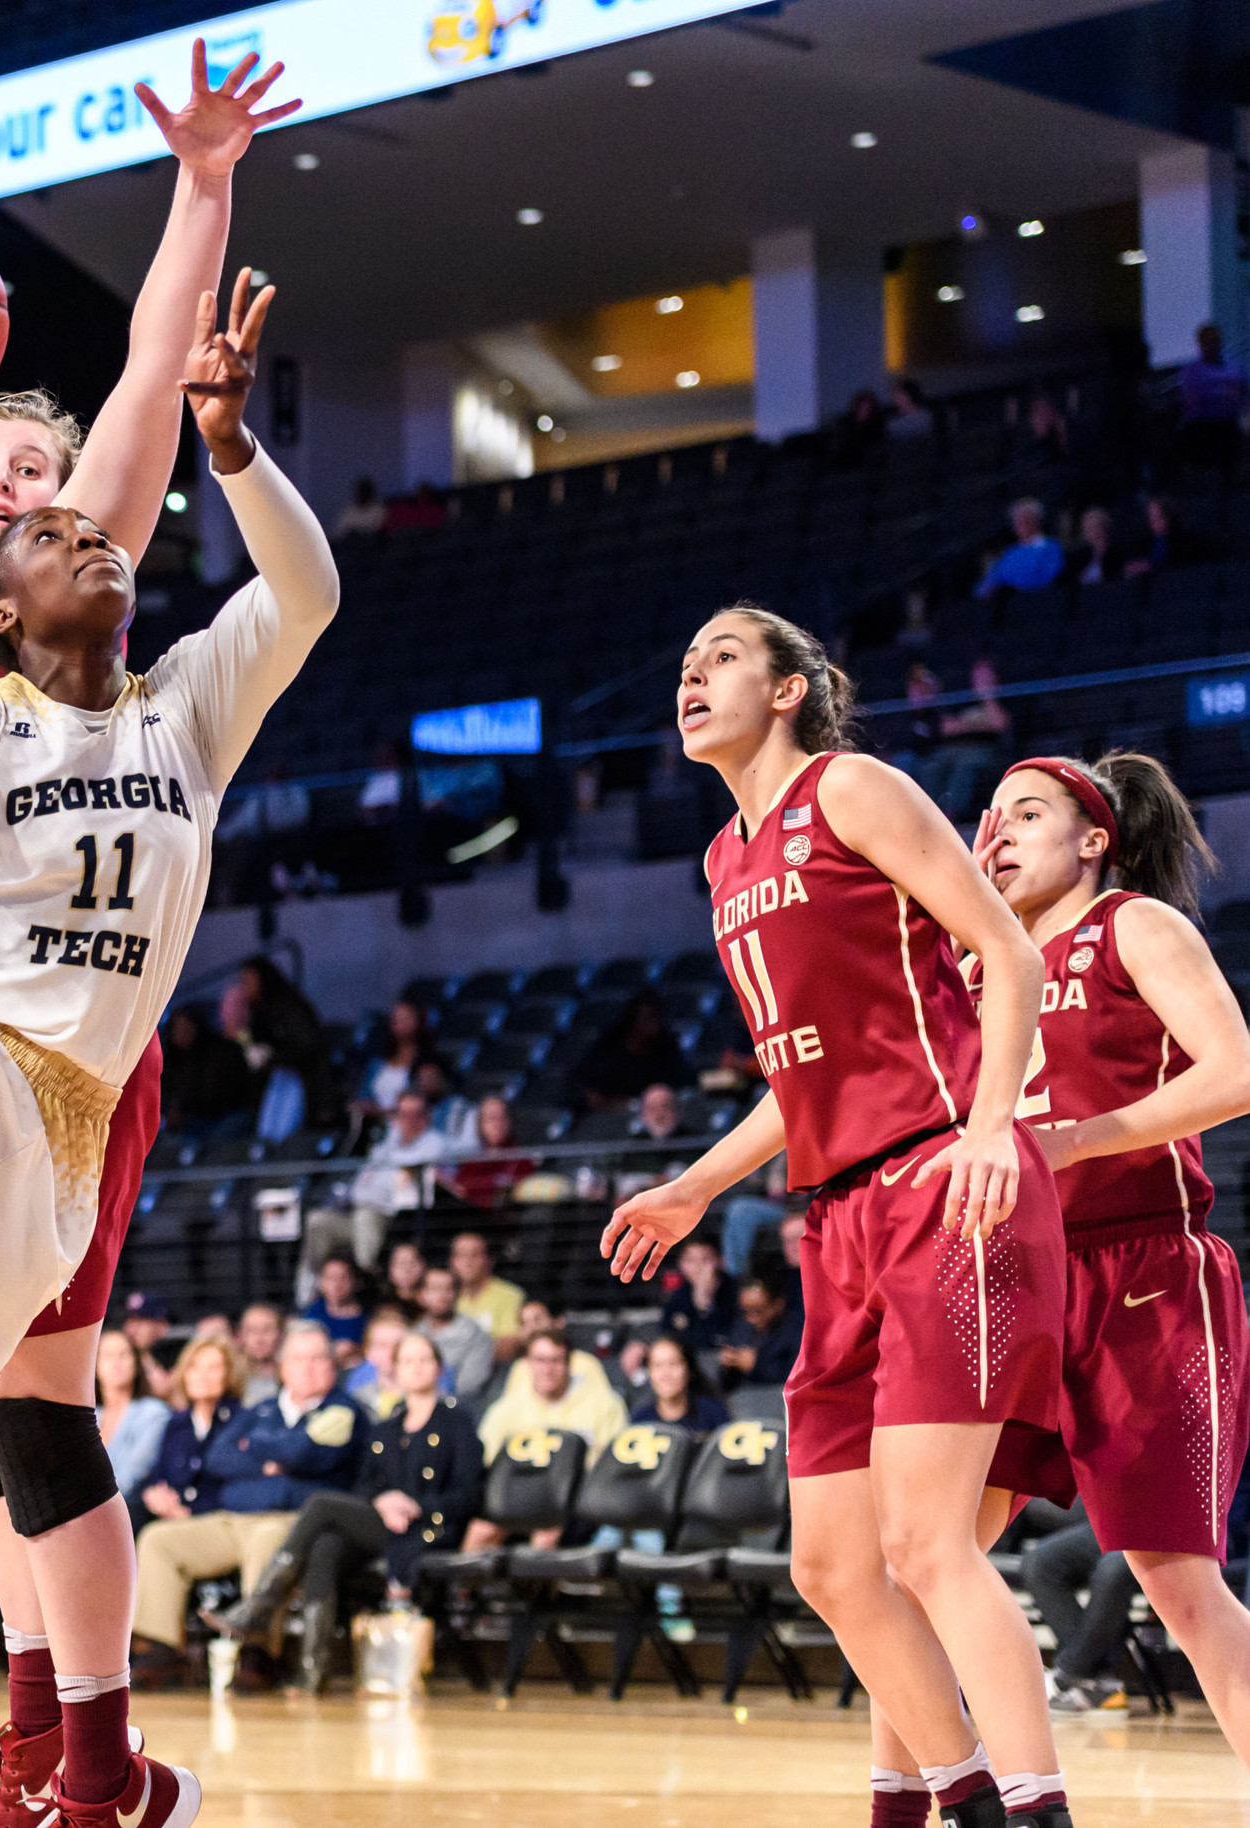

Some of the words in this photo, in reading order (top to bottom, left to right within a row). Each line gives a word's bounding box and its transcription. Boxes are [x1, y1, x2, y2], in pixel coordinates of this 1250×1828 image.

[5, 773, 193, 826] GEORGIA
[70, 831, 136, 912] 11
[713, 870, 809, 942] LORIDA
[27, 924, 151, 977] TECH
[728, 929, 779, 1032] 11
[754, 1025, 824, 1078] TATE
